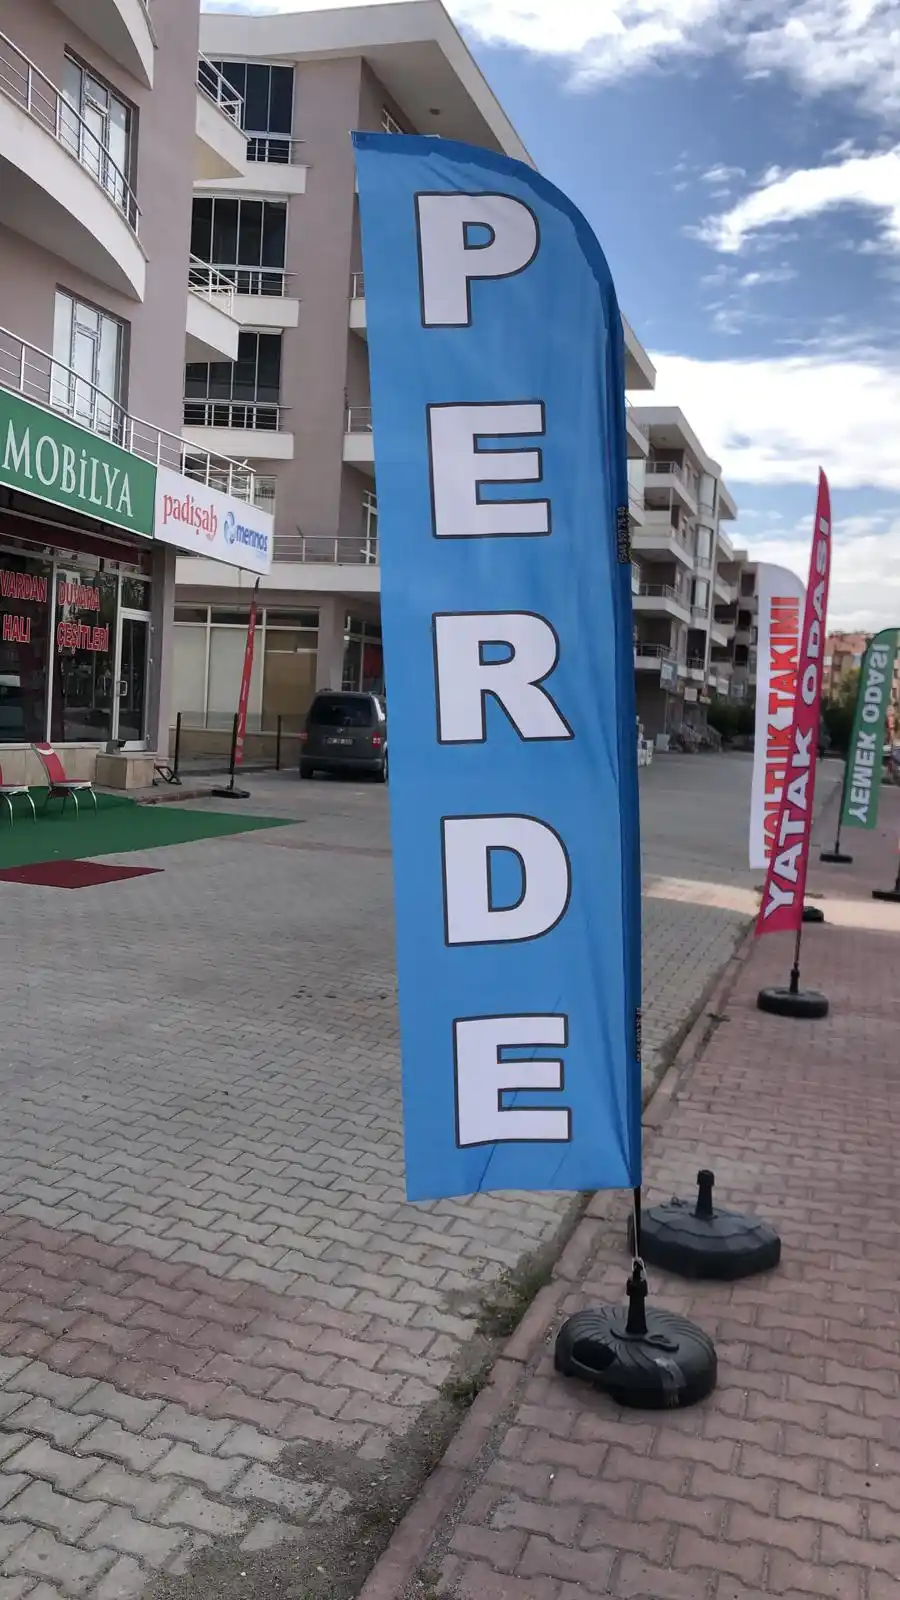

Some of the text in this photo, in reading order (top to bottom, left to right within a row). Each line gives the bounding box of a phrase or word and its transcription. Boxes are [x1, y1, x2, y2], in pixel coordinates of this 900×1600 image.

[162, 492, 218, 538] padişah
[2, 614, 31, 643] HALI
[414, 191, 575, 1148] PERDE
[768, 597, 799, 714] TAKIMI
[763, 516, 830, 919] YATAK ODASI
